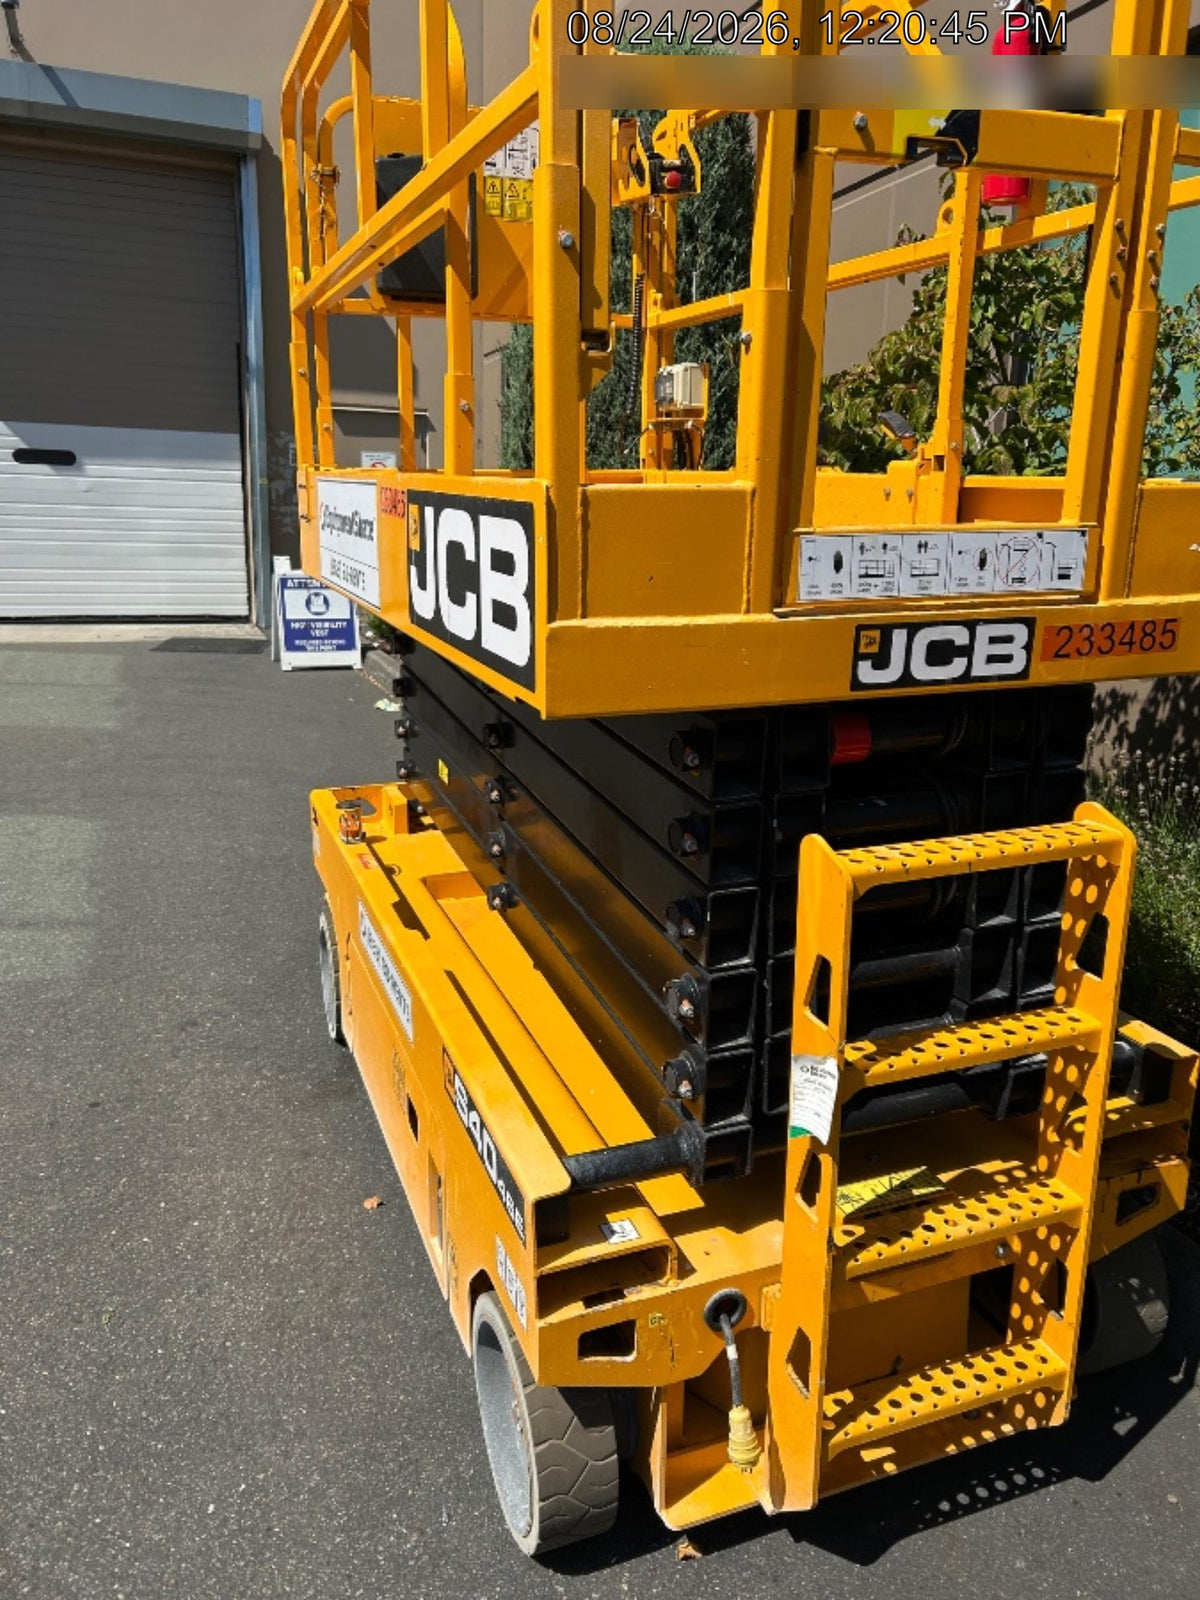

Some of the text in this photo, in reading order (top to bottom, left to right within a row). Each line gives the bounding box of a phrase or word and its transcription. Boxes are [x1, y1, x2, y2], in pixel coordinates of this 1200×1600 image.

[410, 506, 531, 667] JCB
[856, 622, 1029, 684] JCB
[1052, 618, 1178, 659] 233485
